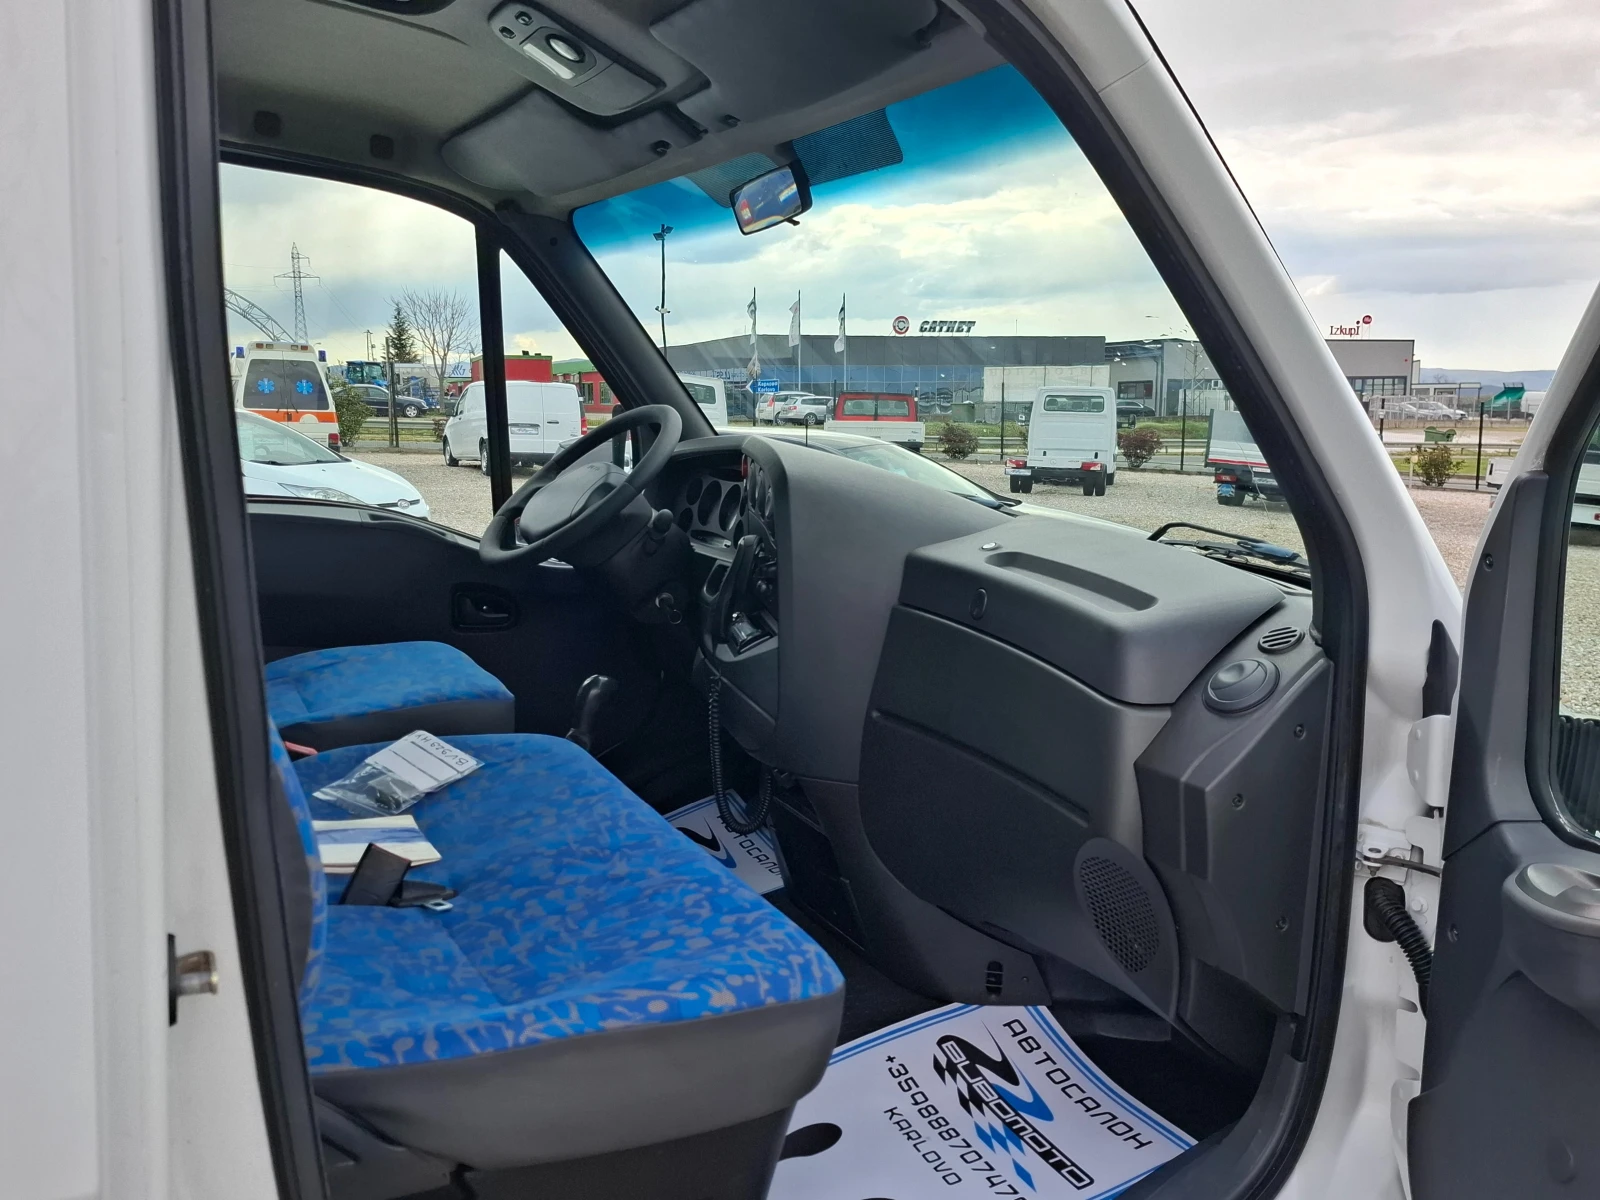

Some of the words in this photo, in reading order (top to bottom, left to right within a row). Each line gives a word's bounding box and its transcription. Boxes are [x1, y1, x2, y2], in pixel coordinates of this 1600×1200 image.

[884, 1105, 963, 1186] KARLOVO
[885, 1054, 1028, 1200] +35988870747
[1002, 1018, 1153, 1150] АВТОСАЛОН
